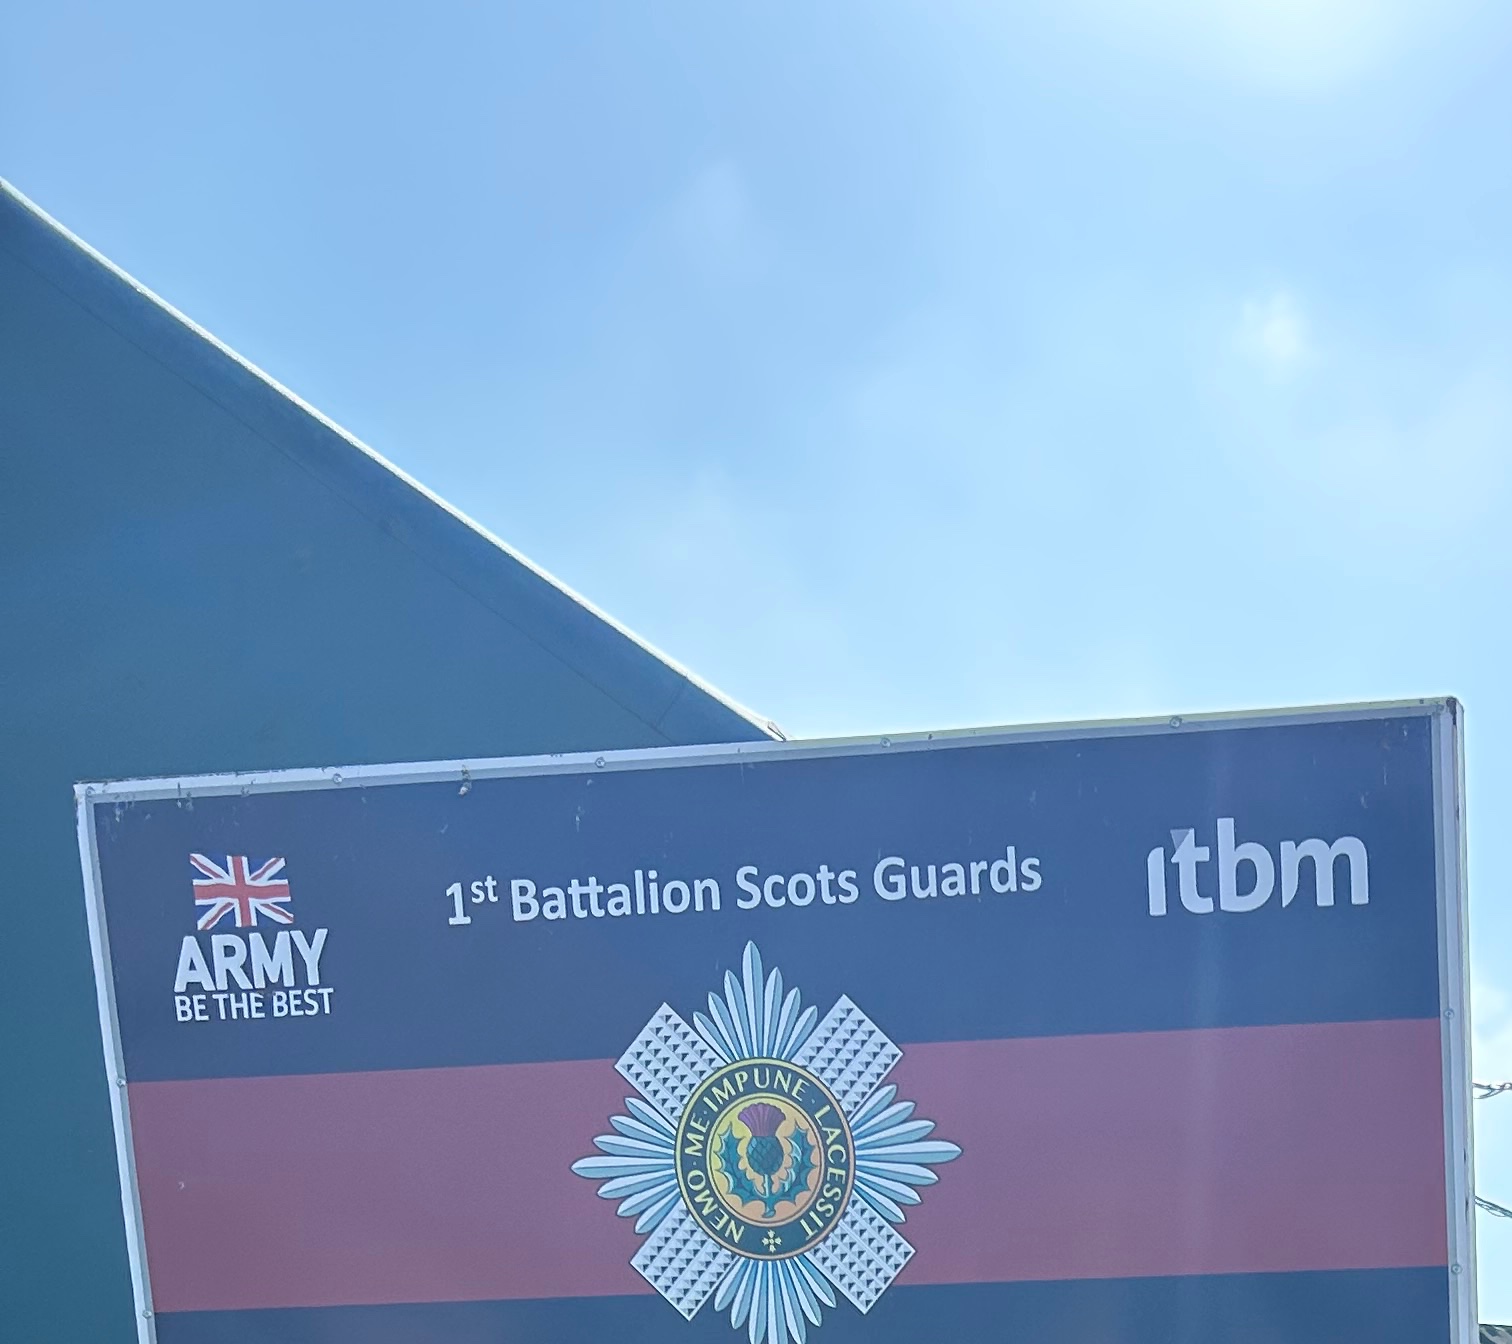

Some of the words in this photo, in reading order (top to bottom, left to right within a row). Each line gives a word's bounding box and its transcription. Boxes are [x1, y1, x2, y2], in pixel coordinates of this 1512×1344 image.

[446, 874, 498, 925] 1st
[510, 869, 721, 922] Battalion
[735, 864, 860, 911] Scots
[873, 846, 1043, 902] Guards
[174, 928, 329, 992] ARMY
[174, 995, 210, 1022] BE
[212, 991, 266, 1020] THE
[272, 988, 334, 1018] BEST
[706, 1067, 811, 1113] IMPUNE
[684, 1115, 711, 1156] ME
[800, 1104, 849, 1241] LACESSIT
[687, 1168, 746, 1245] NEMO
